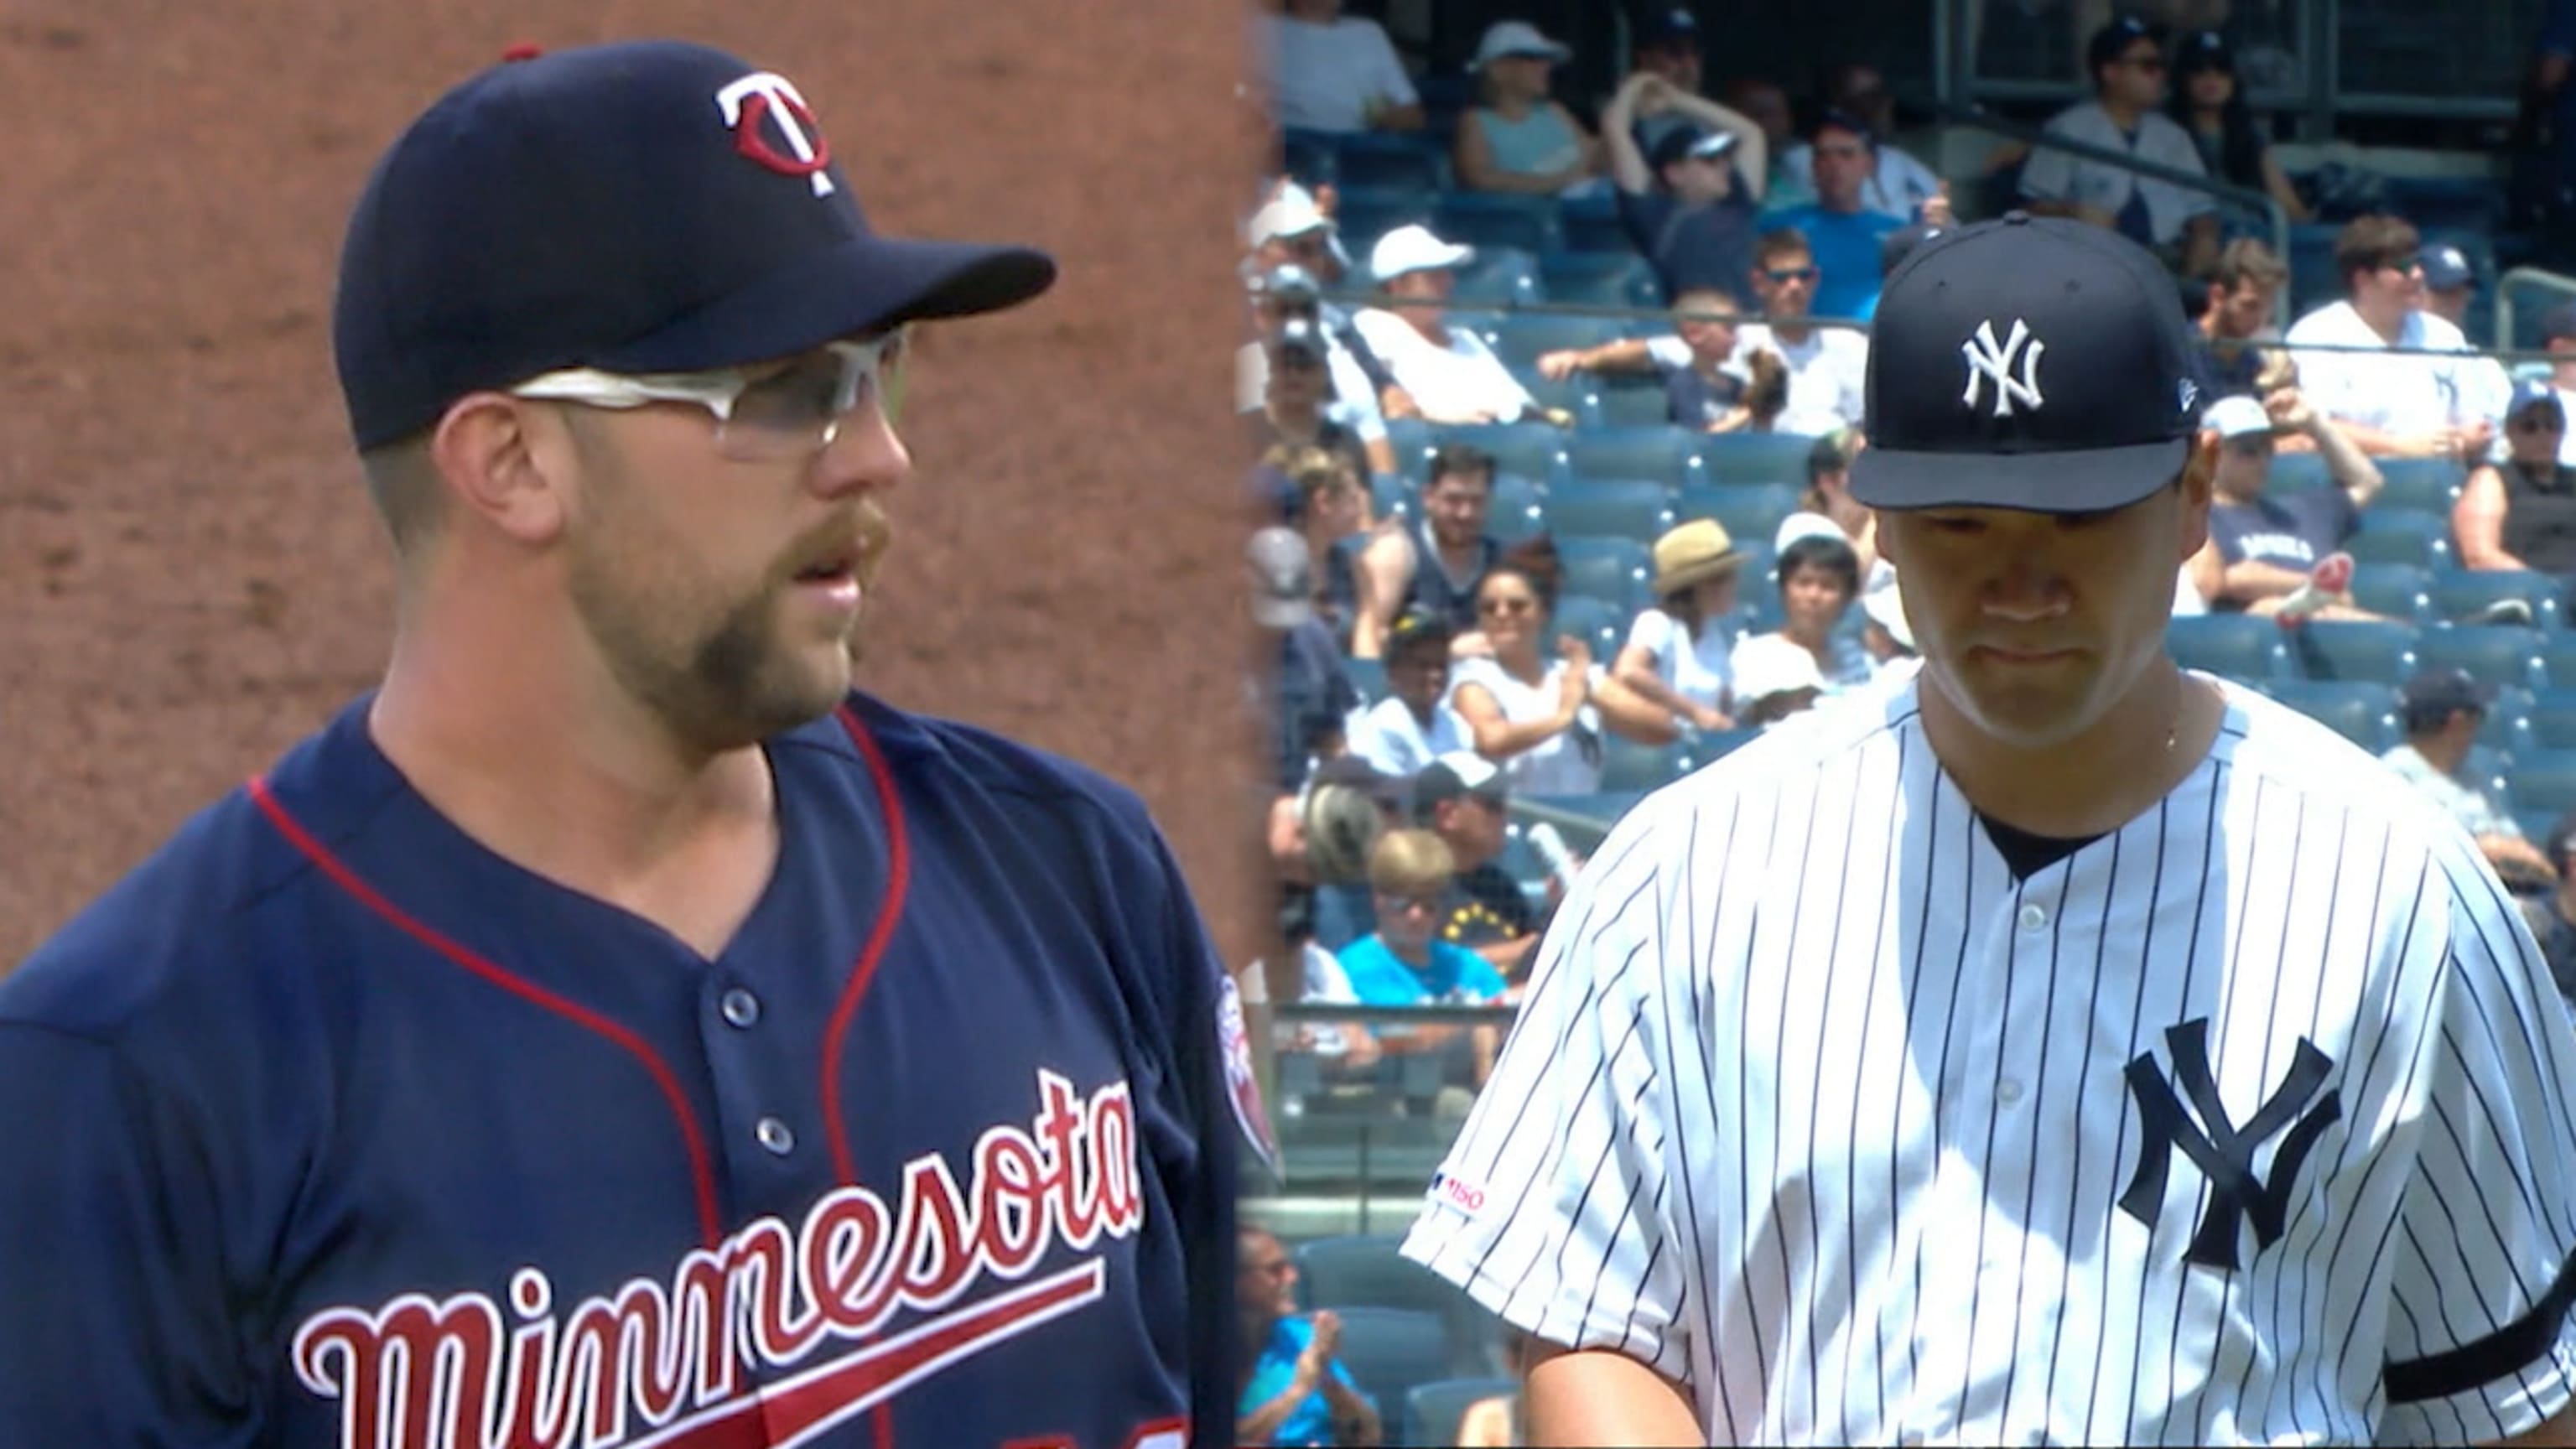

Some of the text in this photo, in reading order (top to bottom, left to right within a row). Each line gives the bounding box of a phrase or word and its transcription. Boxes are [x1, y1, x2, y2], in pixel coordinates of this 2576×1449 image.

[1961, 317, 2045, 416] NY
[293, 1067, 1145, 1447] Minnesota
[2117, 1017, 2342, 1272] NY
